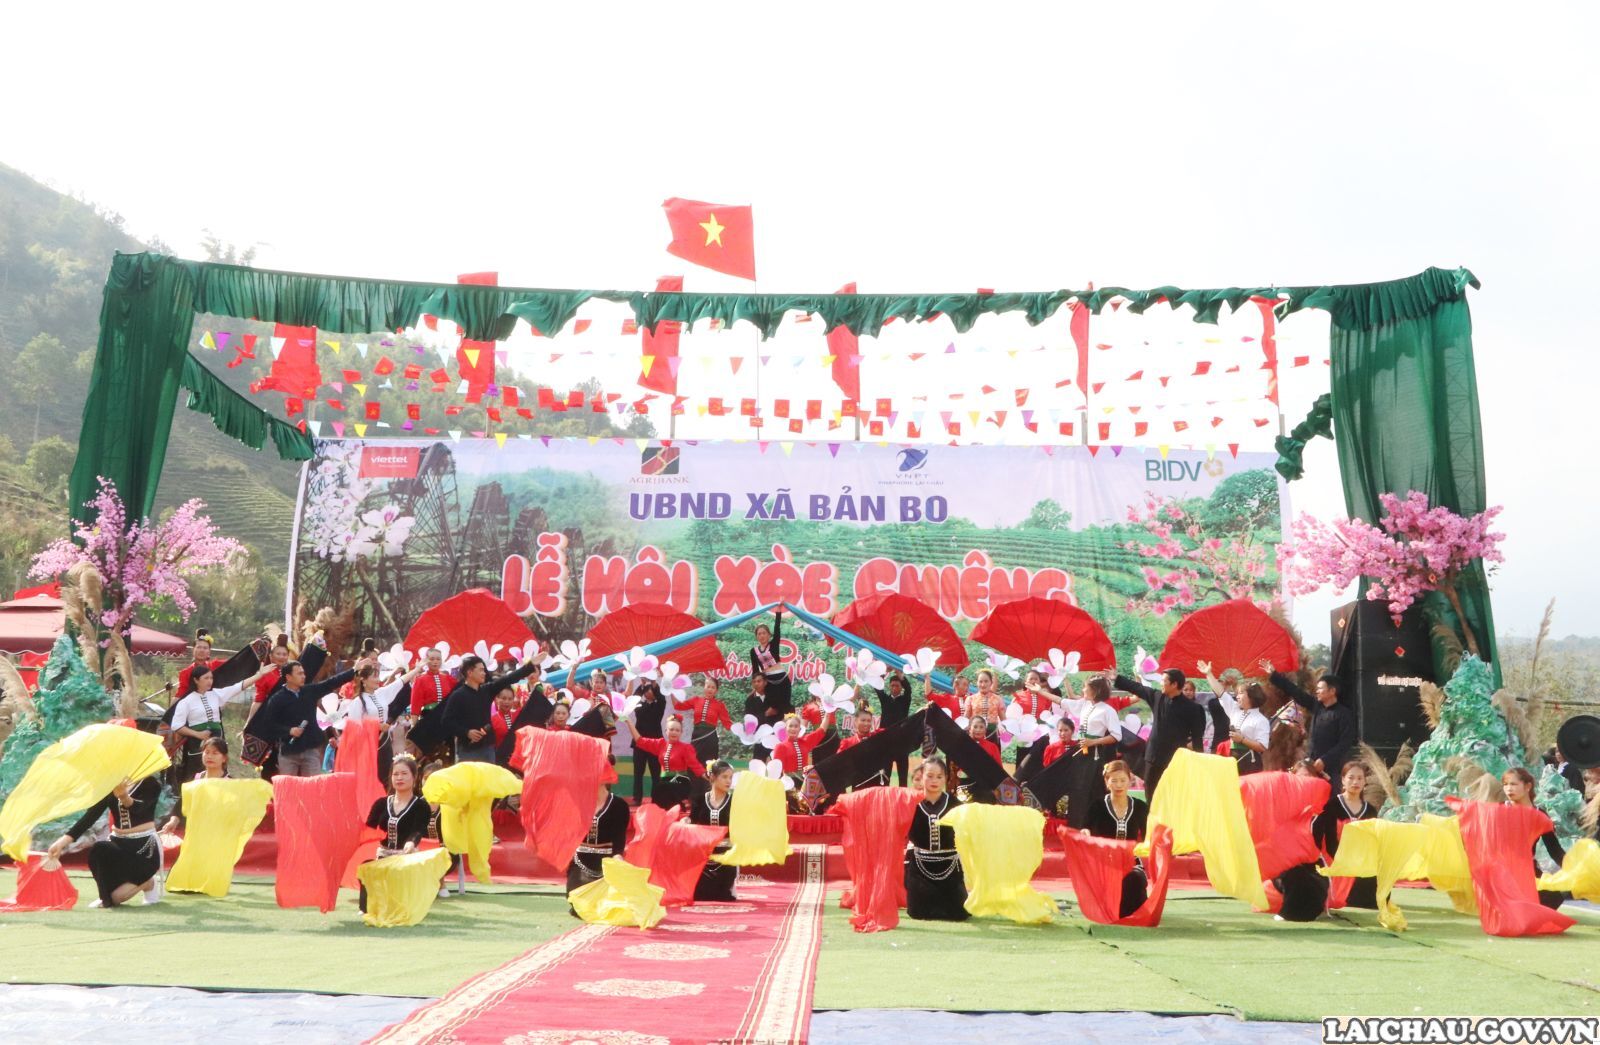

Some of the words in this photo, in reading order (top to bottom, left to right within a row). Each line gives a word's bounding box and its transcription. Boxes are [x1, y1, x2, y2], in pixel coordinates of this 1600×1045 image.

[371, 455, 409, 464] viettel
[1145, 459, 1203, 482] BIDV
[629, 491, 732, 521] UBND
[745, 488, 797, 521] XÃ
[808, 486, 886, 522] BẢN
[901, 495, 949, 524] BO
[502, 532, 568, 617] LỄ
[713, 543, 838, 617] XÒE
[853, 549, 1076, 621] CHIÊNG
